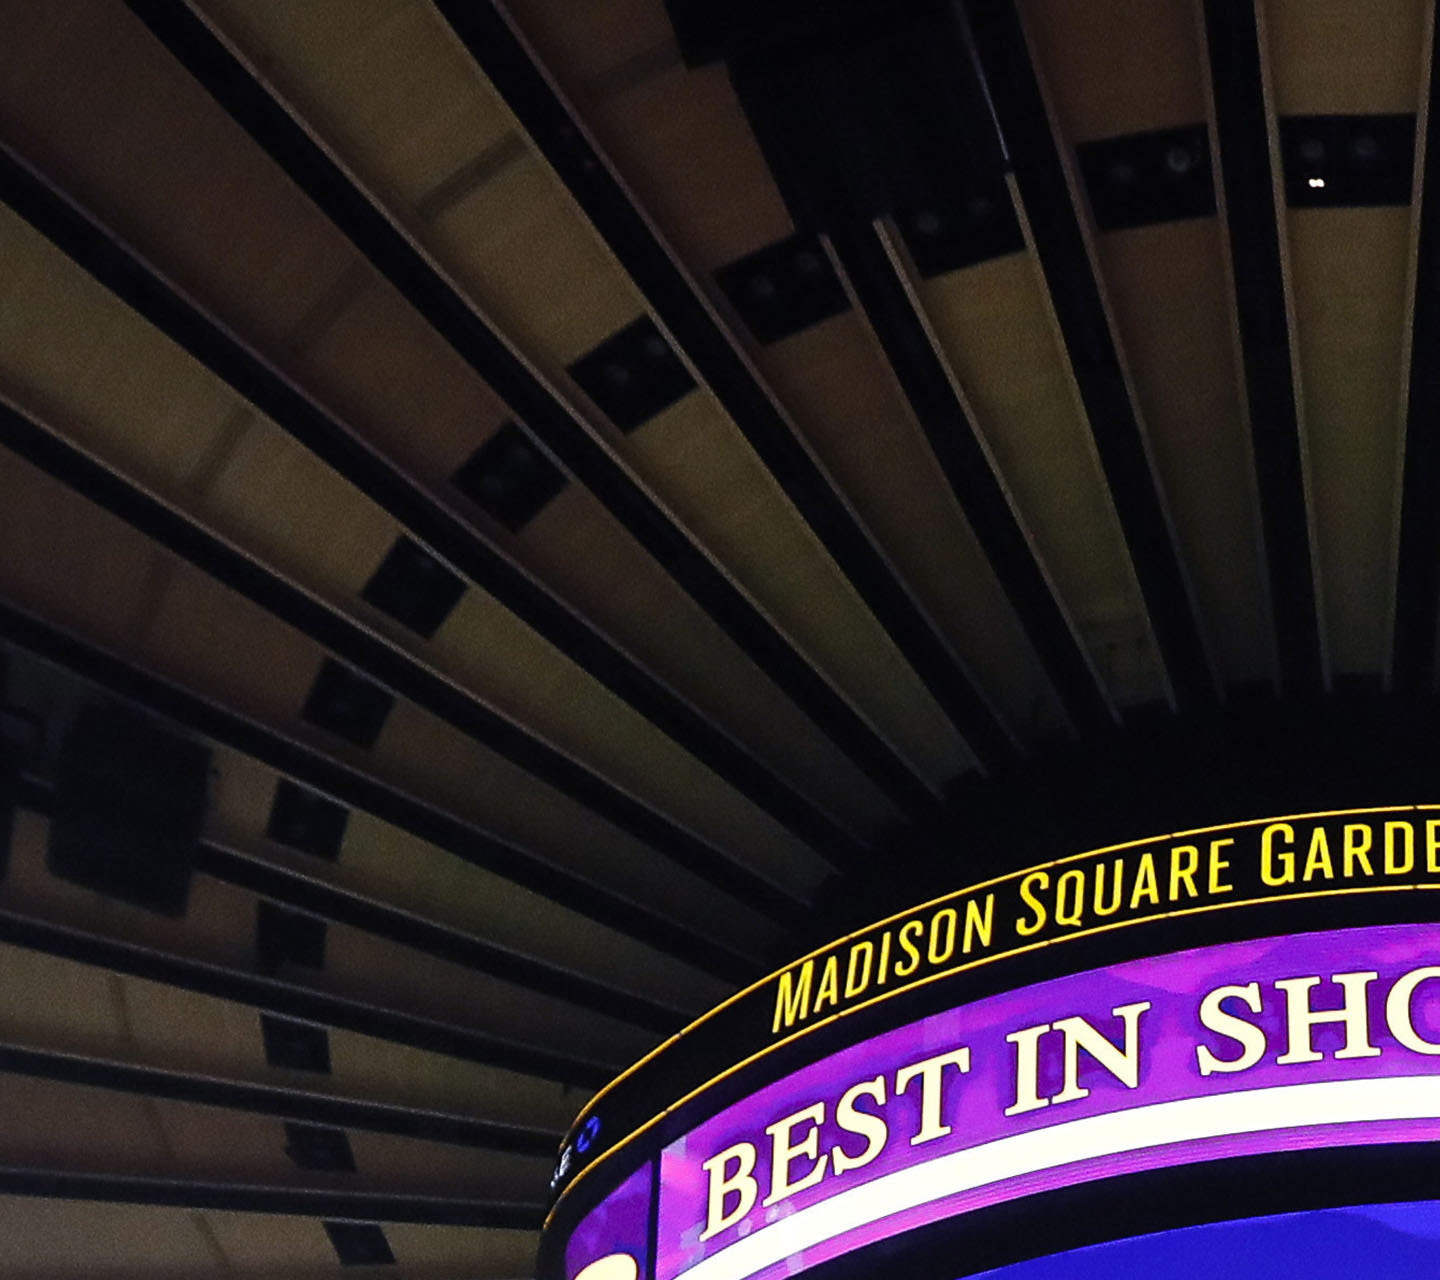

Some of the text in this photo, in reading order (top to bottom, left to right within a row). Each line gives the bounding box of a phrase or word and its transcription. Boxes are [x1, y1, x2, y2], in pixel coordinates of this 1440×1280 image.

[771, 893, 995, 1034] MADISON
[1014, 837, 1236, 937] SQUARE
[699, 1048, 972, 1242] BEST
[1003, 1001, 1152, 1117] IN
